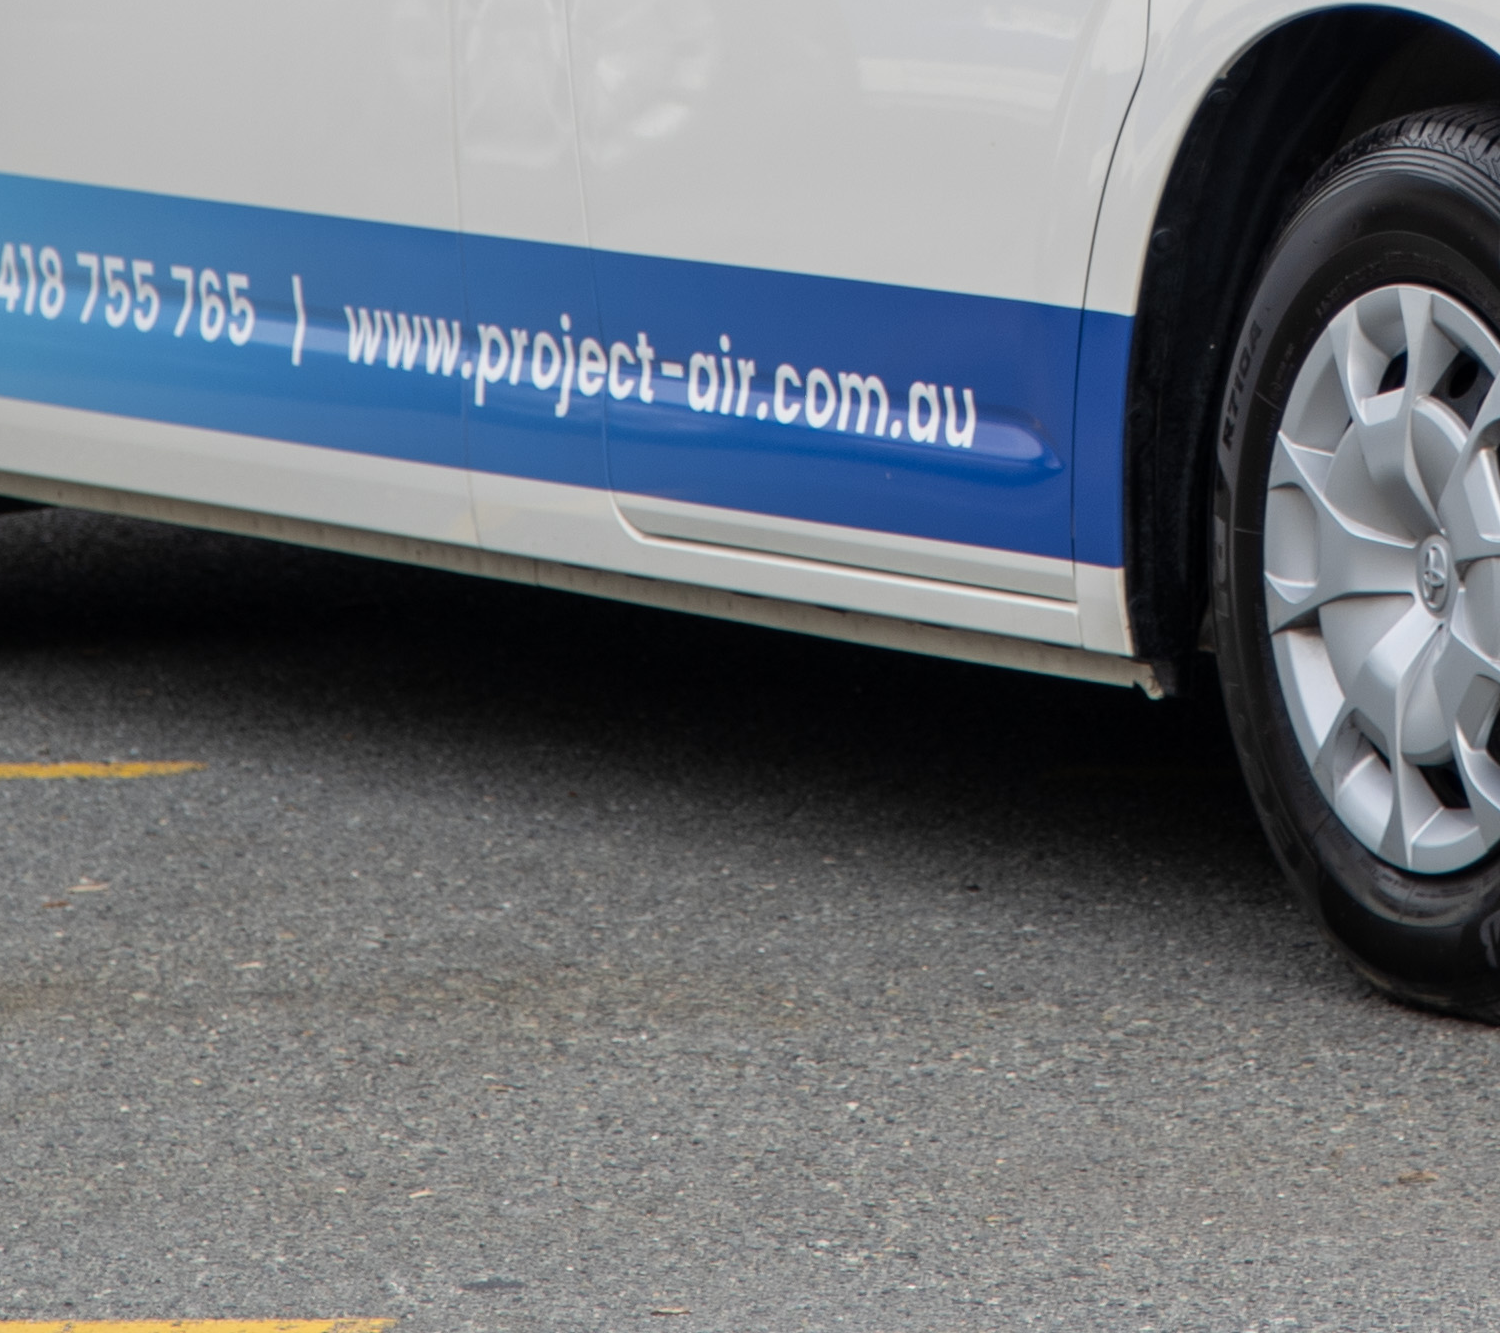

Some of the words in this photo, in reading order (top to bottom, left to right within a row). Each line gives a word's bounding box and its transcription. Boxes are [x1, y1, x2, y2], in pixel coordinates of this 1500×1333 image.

[76, 251, 160, 332] 755
[170, 265, 256, 347] 765
[344, 305, 977, 449] www.project-air.com.au
